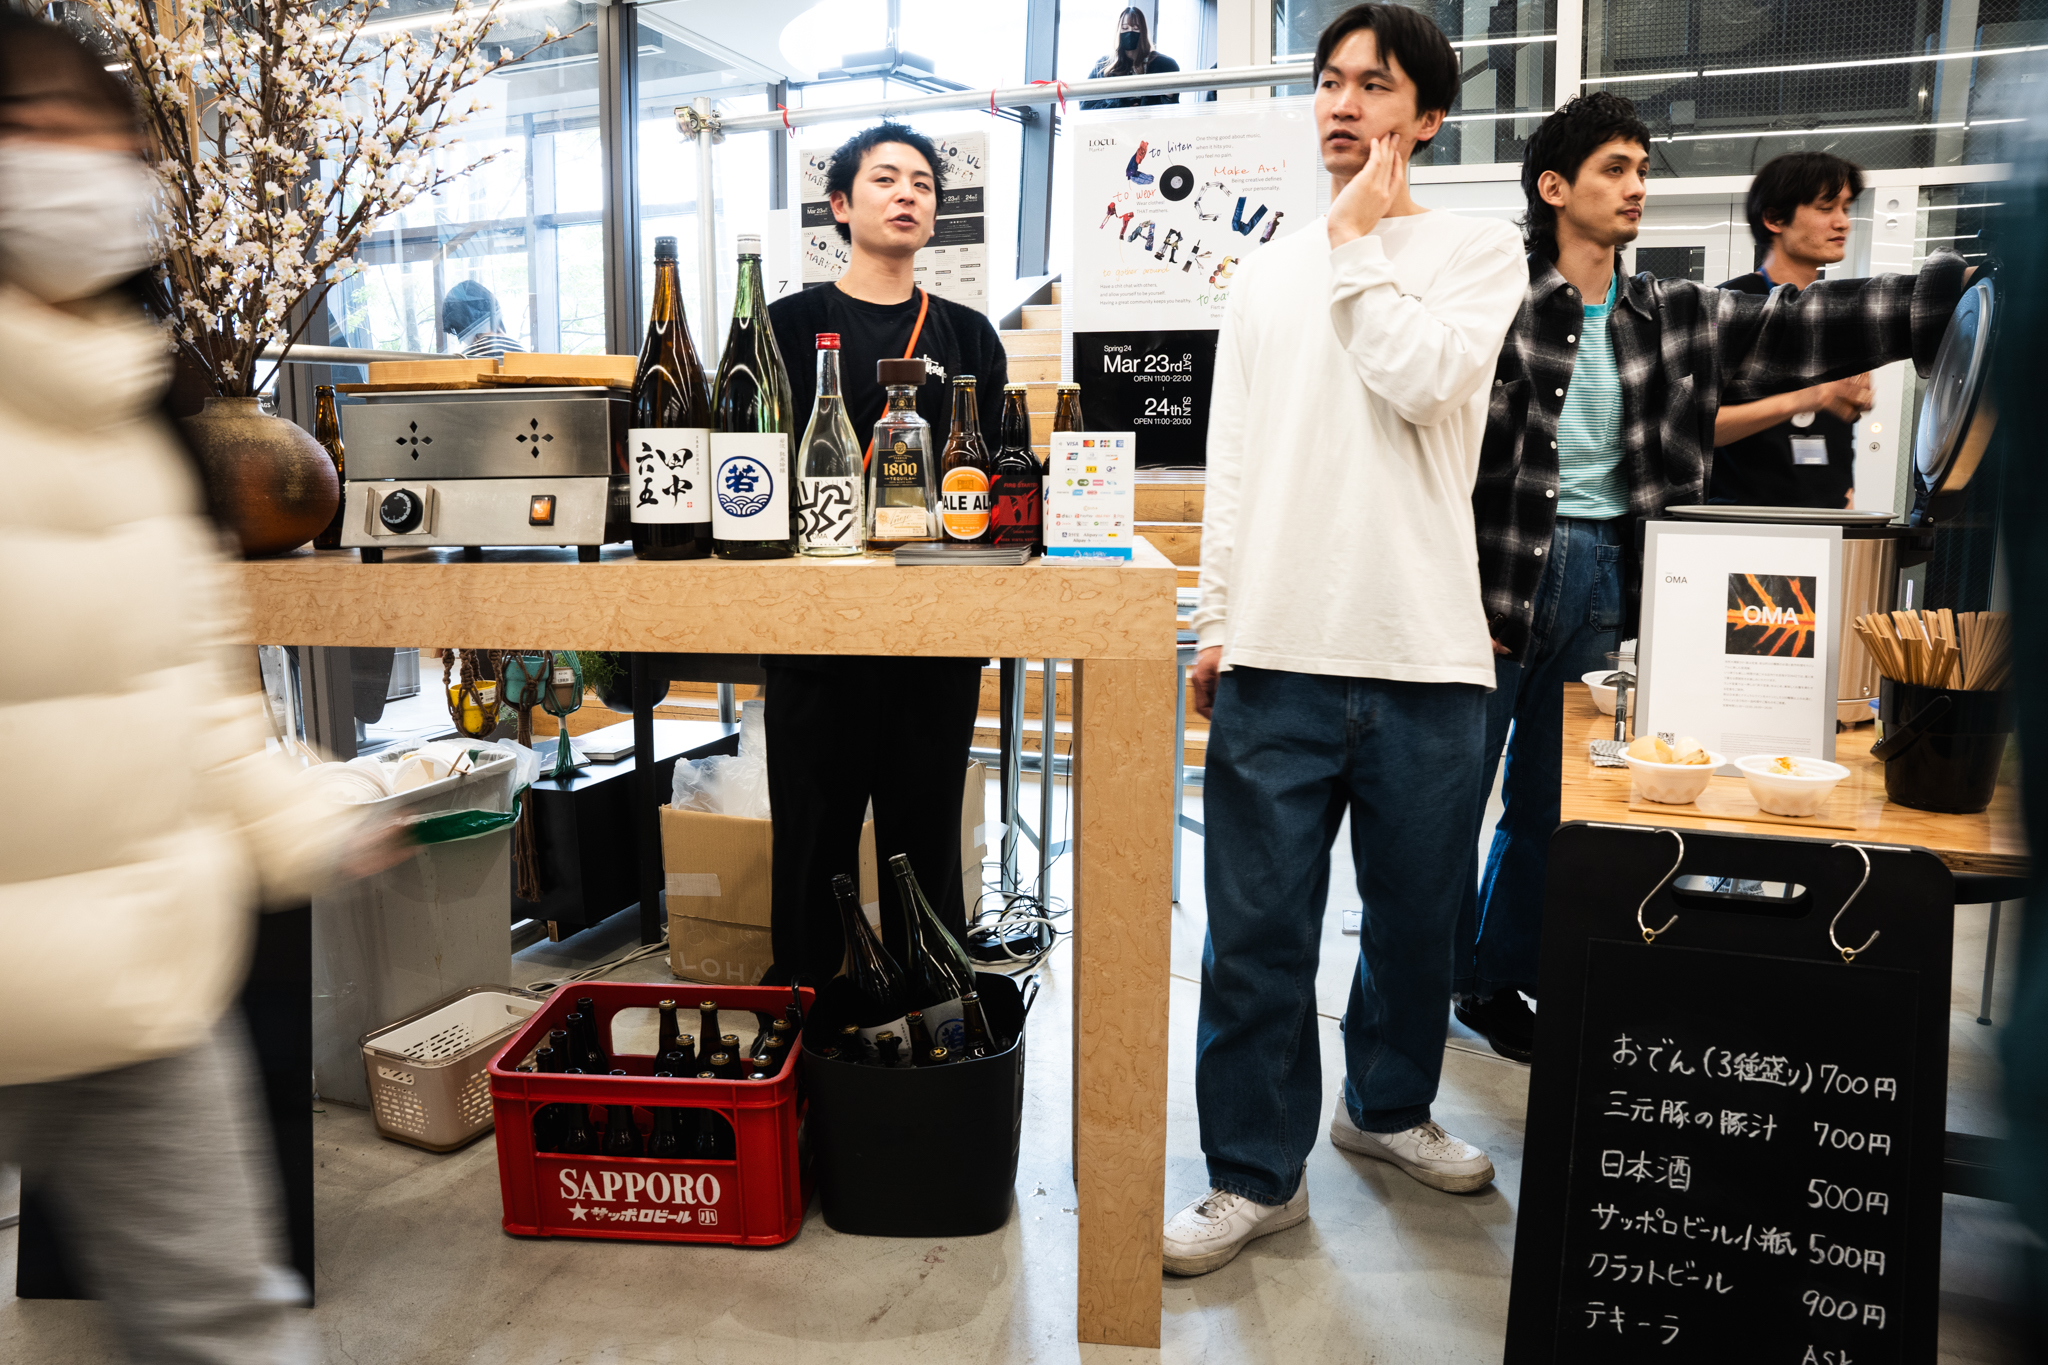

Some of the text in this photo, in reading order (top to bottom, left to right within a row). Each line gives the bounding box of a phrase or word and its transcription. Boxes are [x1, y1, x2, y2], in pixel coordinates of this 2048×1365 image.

[1149, 141, 1193, 158] to listen
[1214, 166, 1249, 176] Make
[1113, 189, 1156, 202] to wear
[1103, 268, 1111, 277] to
[1142, 264, 1171, 276] around
[779, 280, 789, 293] 7
[1196, 294, 1209, 306] to
[1104, 345, 1123, 353] Spring
[1104, 353, 1192, 373] Mar 23rd SAT
[1144, 396, 1192, 416] 24th SUN
[635, 442, 659, 508] 六五
[655, 448, 693, 509] 田中
[725, 464, 759, 494] 若
[883, 462, 917, 476] 1800
[1665, 575, 1688, 584] OMA
[1743, 605, 1799, 625] OMA
[1820, 1064, 1897, 1101] 700円
[1604, 1090, 1891, 1156] 三元豚の豚汁 700円
[559, 1168, 721, 1206] SAPPORO
[1601, 1150, 1889, 1215] 日本酒 500円
[590, 1206, 692, 1224] サッポロビール
[1591, 1203, 1886, 1276] サッポロビール小瓶 500円
[1588, 1253, 1734, 1294] クラフトビール
[1802, 1290, 1886, 1329] 900円
[1585, 1301, 1680, 1345] テキーラ
